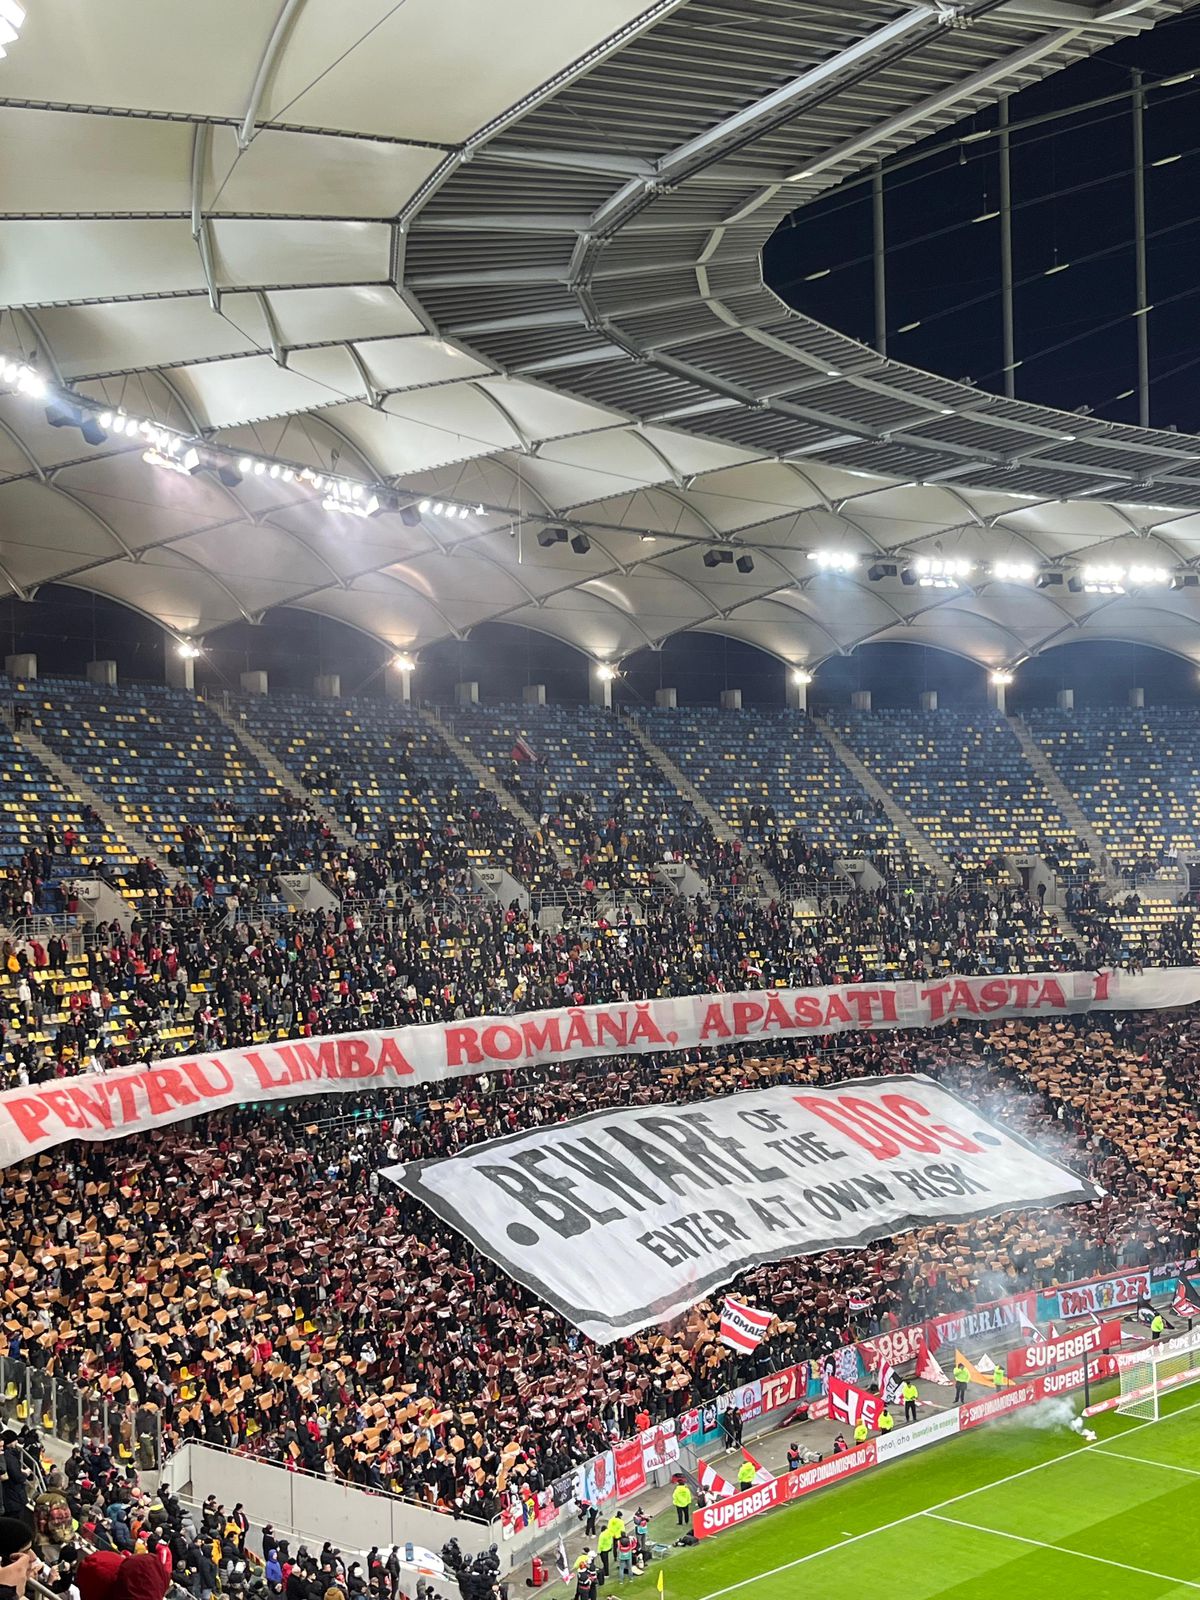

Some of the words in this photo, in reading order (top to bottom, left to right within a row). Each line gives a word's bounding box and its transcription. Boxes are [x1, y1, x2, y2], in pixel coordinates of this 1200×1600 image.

[2, 1059, 233, 1143] PENTRU
[243, 1037, 414, 1091] LIMBA
[445, 1001, 678, 1066] ROMÂNĂ,
[922, 977, 1068, 1021] TASTA
[1094, 973, 1109, 1001] 1
[472, 1111, 790, 1239] BEWARE
[737, 1109, 788, 1133] OF
[764, 1132, 848, 1167] THE
[636, 1209, 751, 1267] ENTER
[747, 1195, 806, 1231] AT
[803, 1174, 895, 1221] OWN
[889, 1163, 991, 1200] RISK
[1025, 1326, 1101, 1367] SUPERBET
[1044, 1359, 1099, 1393] SUPERBET
[703, 1480, 778, 1529] SUPERBET
